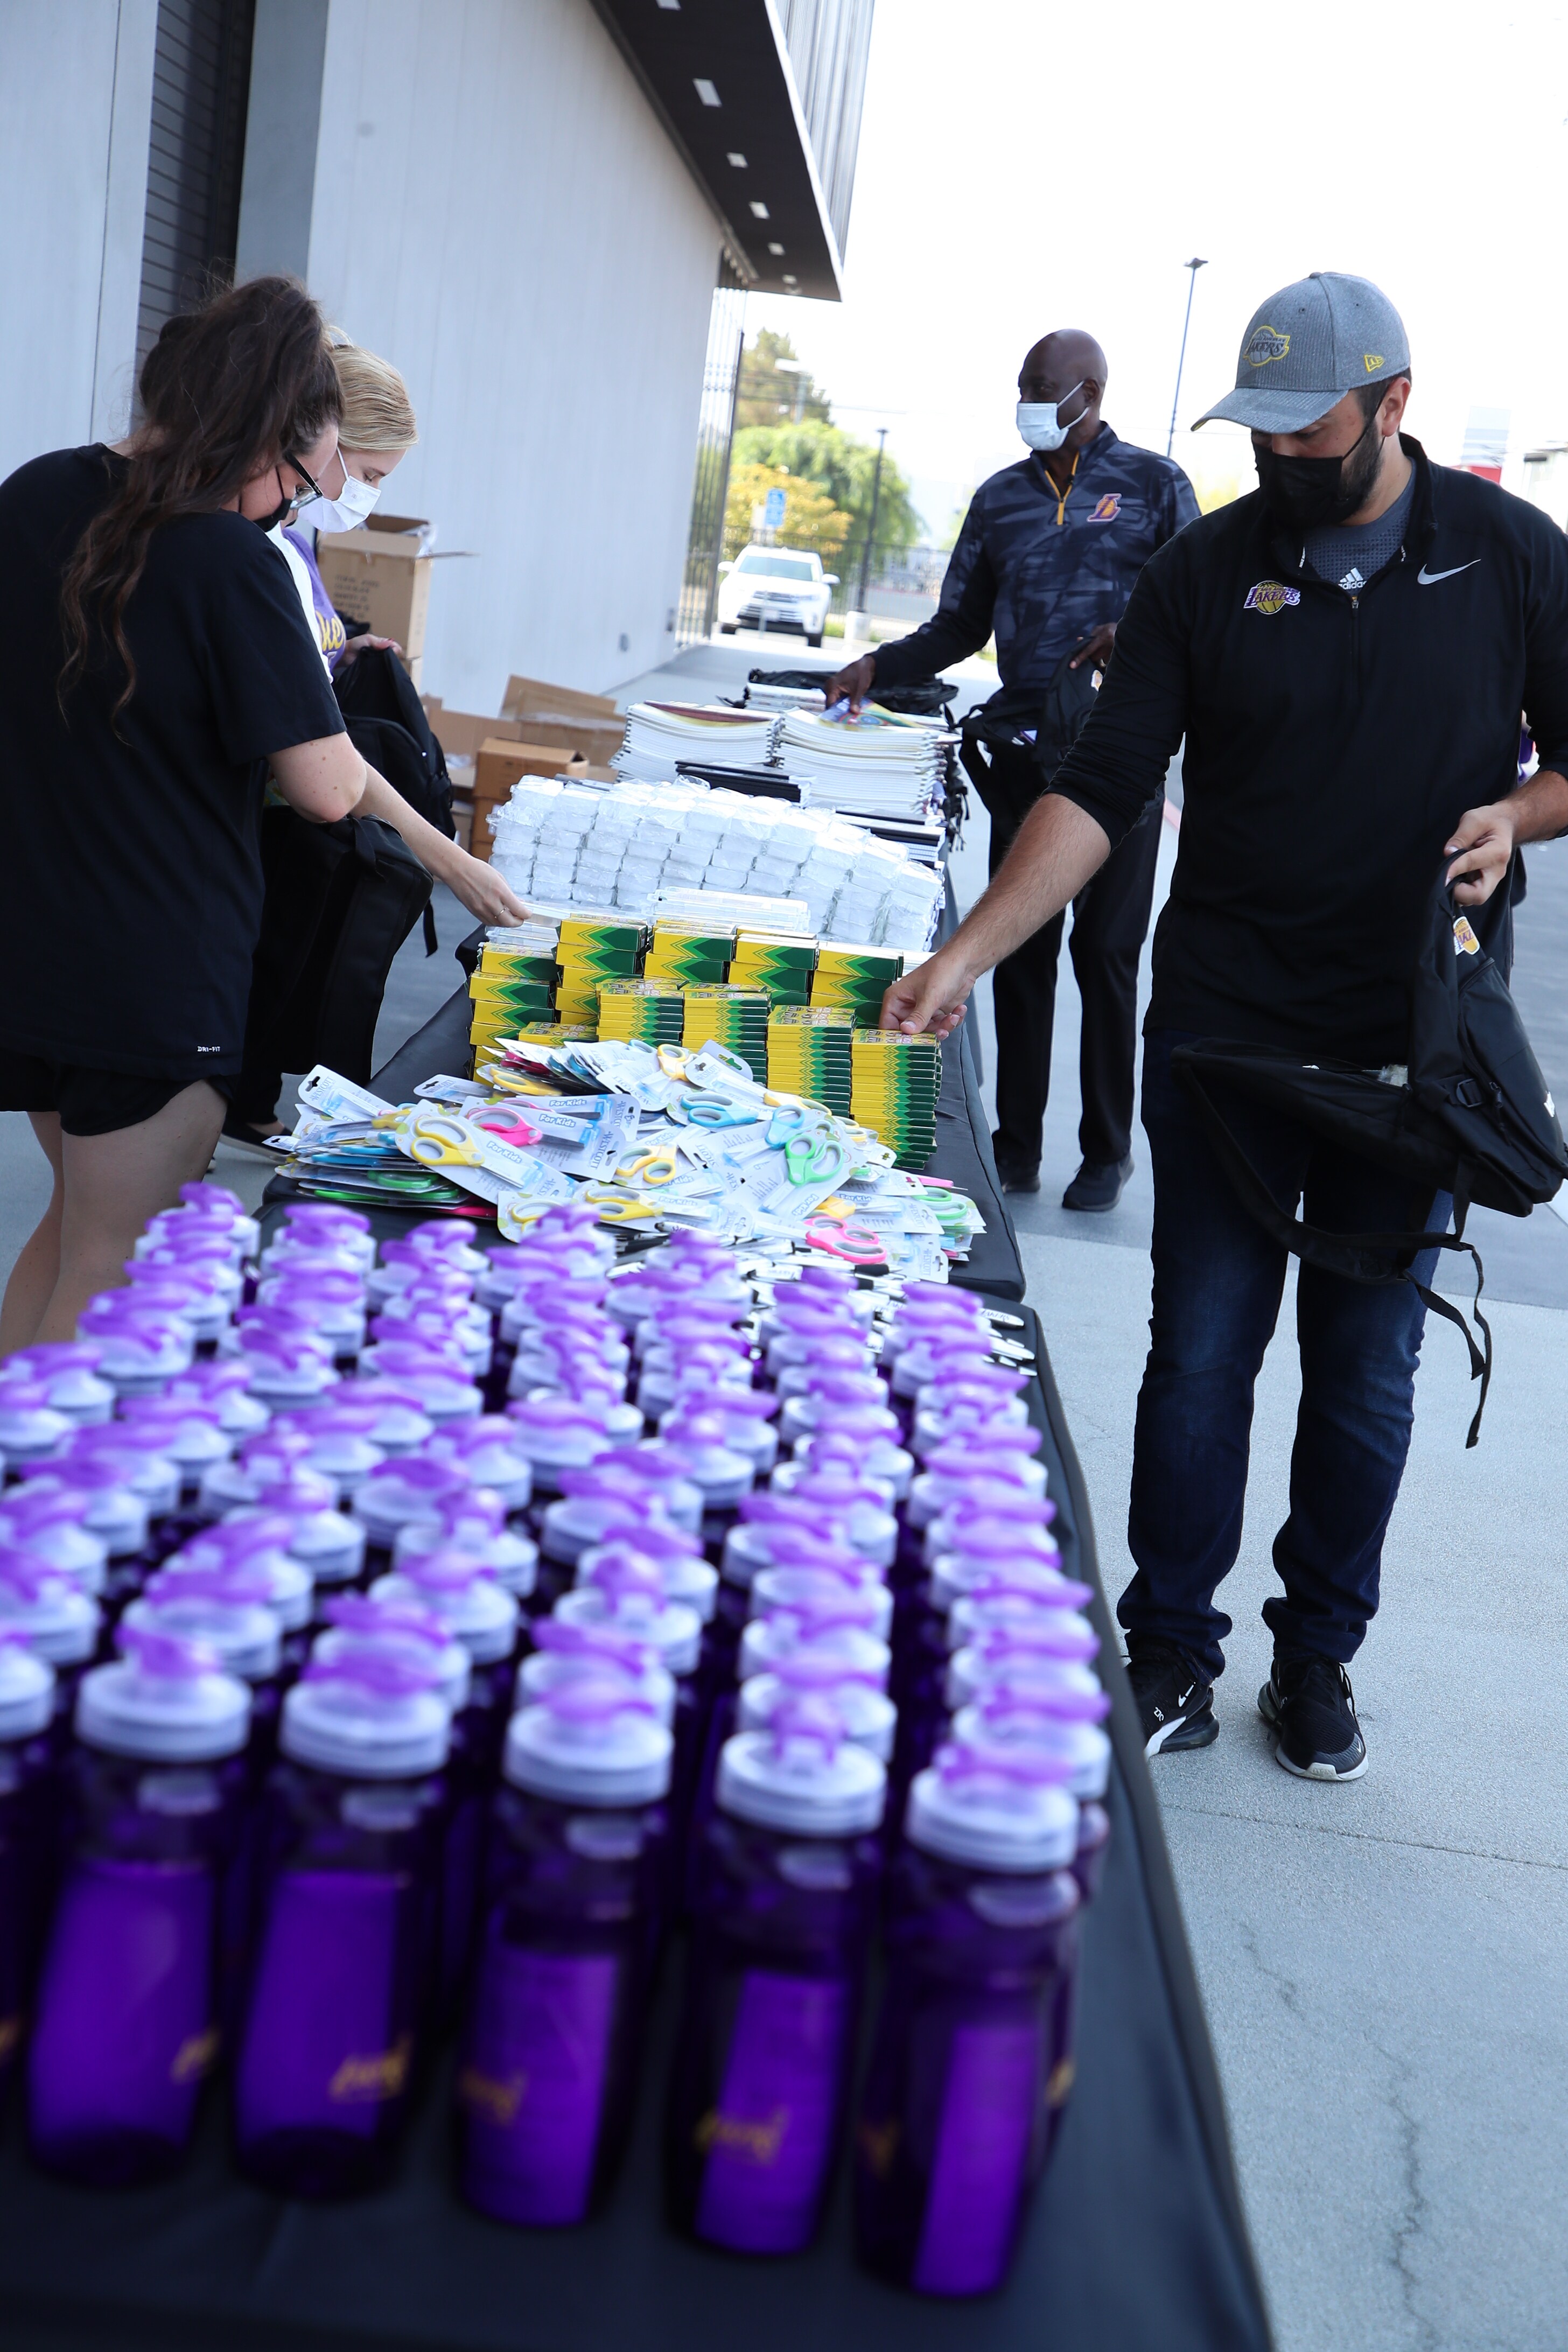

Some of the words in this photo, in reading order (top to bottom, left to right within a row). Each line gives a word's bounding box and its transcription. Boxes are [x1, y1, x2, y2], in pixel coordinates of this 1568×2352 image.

[1243, 587, 1300, 607] LAKERS
[309, 1076, 334, 1102] WESTCOTT
[538, 1114, 555, 1124] For
[555, 1117, 576, 1128] Kids
[613, 1100, 626, 1126] WESTCO
[486, 1140, 504, 1154] For
[500, 1147, 523, 1164] Kids
[590, 1131, 614, 1170] WESTCOTT
[673, 1175, 694, 1185] Kids
[675, 1197, 698, 1206] Kids
[839, 1193, 857, 1201] For
[792, 1202, 810, 1216] Kids
[922, 1248, 933, 1276] WESTCOTT
